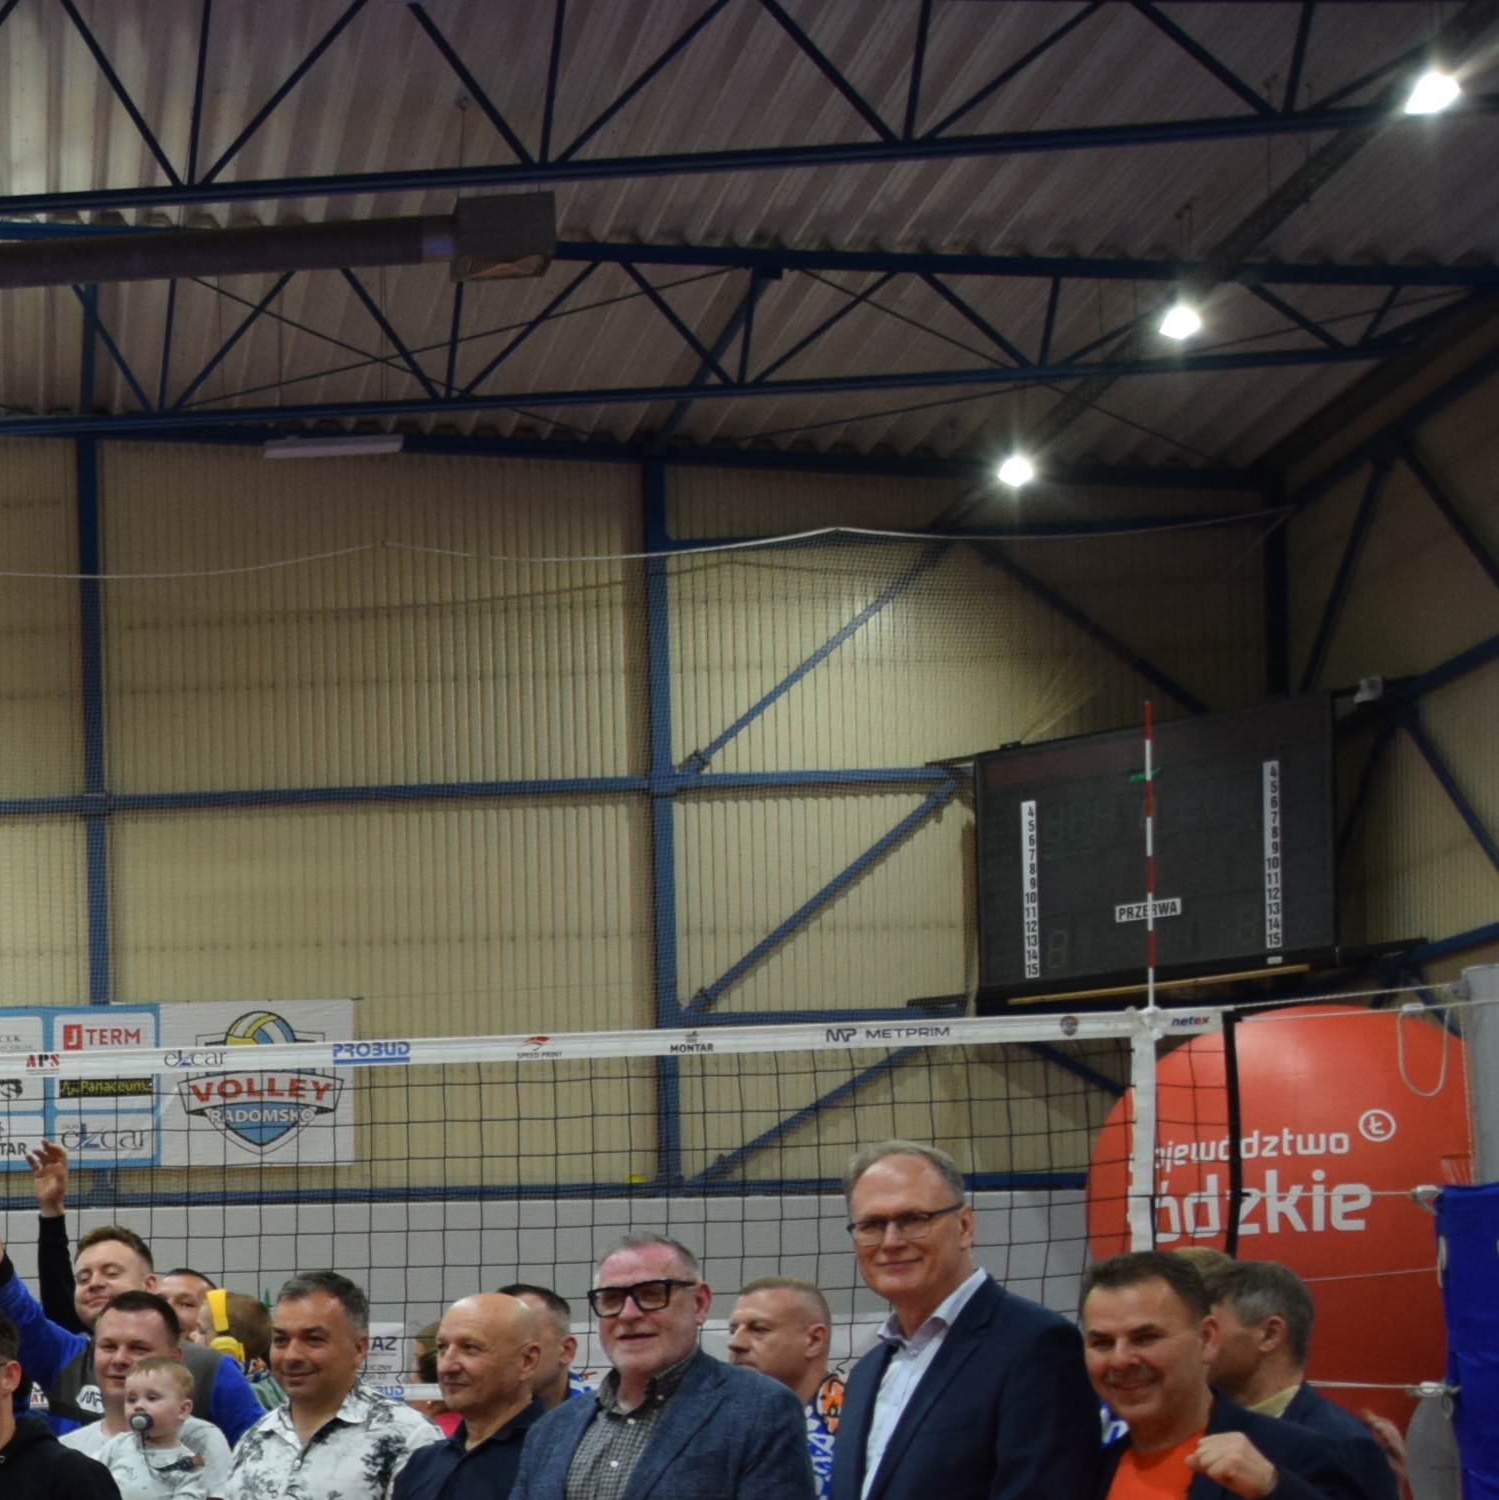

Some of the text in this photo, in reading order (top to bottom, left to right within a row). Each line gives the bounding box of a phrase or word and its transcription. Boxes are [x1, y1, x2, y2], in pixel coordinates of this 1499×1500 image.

[1270, 765, 1277, 778] 4
[1270, 780, 1277, 793] 5
[1270, 796, 1278, 808] 6
[1027, 806, 1034, 817] 4
[1271, 811, 1278, 824] 7
[1028, 820, 1035, 832] 5
[1271, 826, 1278, 839] 8
[1028, 834, 1035, 846] 6
[1271, 841, 1278, 854] 9
[1028, 848, 1035, 861] 7
[1029, 862, 1036, 875] 8
[1266, 858, 1279, 870] 10
[1029, 877, 1036, 889] 9
[1266, 873, 1279, 885] 11
[1025, 892, 1036, 904] 10
[1267, 888, 1280, 900] 12
[1025, 906, 1036, 918] 11
[1118, 901, 1177, 919] PRZERWA
[1267, 902, 1280, 915] 13
[1026, 921, 1037, 933] 12
[1267, 918, 1280, 930] 14
[1026, 935, 1037, 947] 13
[1268, 933, 1281, 946] 15
[1026, 950, 1038, 961] 14
[1027, 964, 1038, 976] 15
[1171, 1014, 1210, 1027] netex
[865, 1027, 951, 1039] METPRIM
[333, 1041, 411, 1058] PROBUD
[670, 1043, 714, 1053] MONTAR
[541, 1051, 562, 1059] PRINT
[25, 1054, 60, 1069] APS
[81, 1080, 146, 1093] Panaceum
[189, 1078, 333, 1103] VOLLEY
[210, 1107, 316, 1124] RADOMSKO
[1128, 1128, 1349, 1174] ojewództwo
[1127, 1169, 1373, 1243] ódzkie
